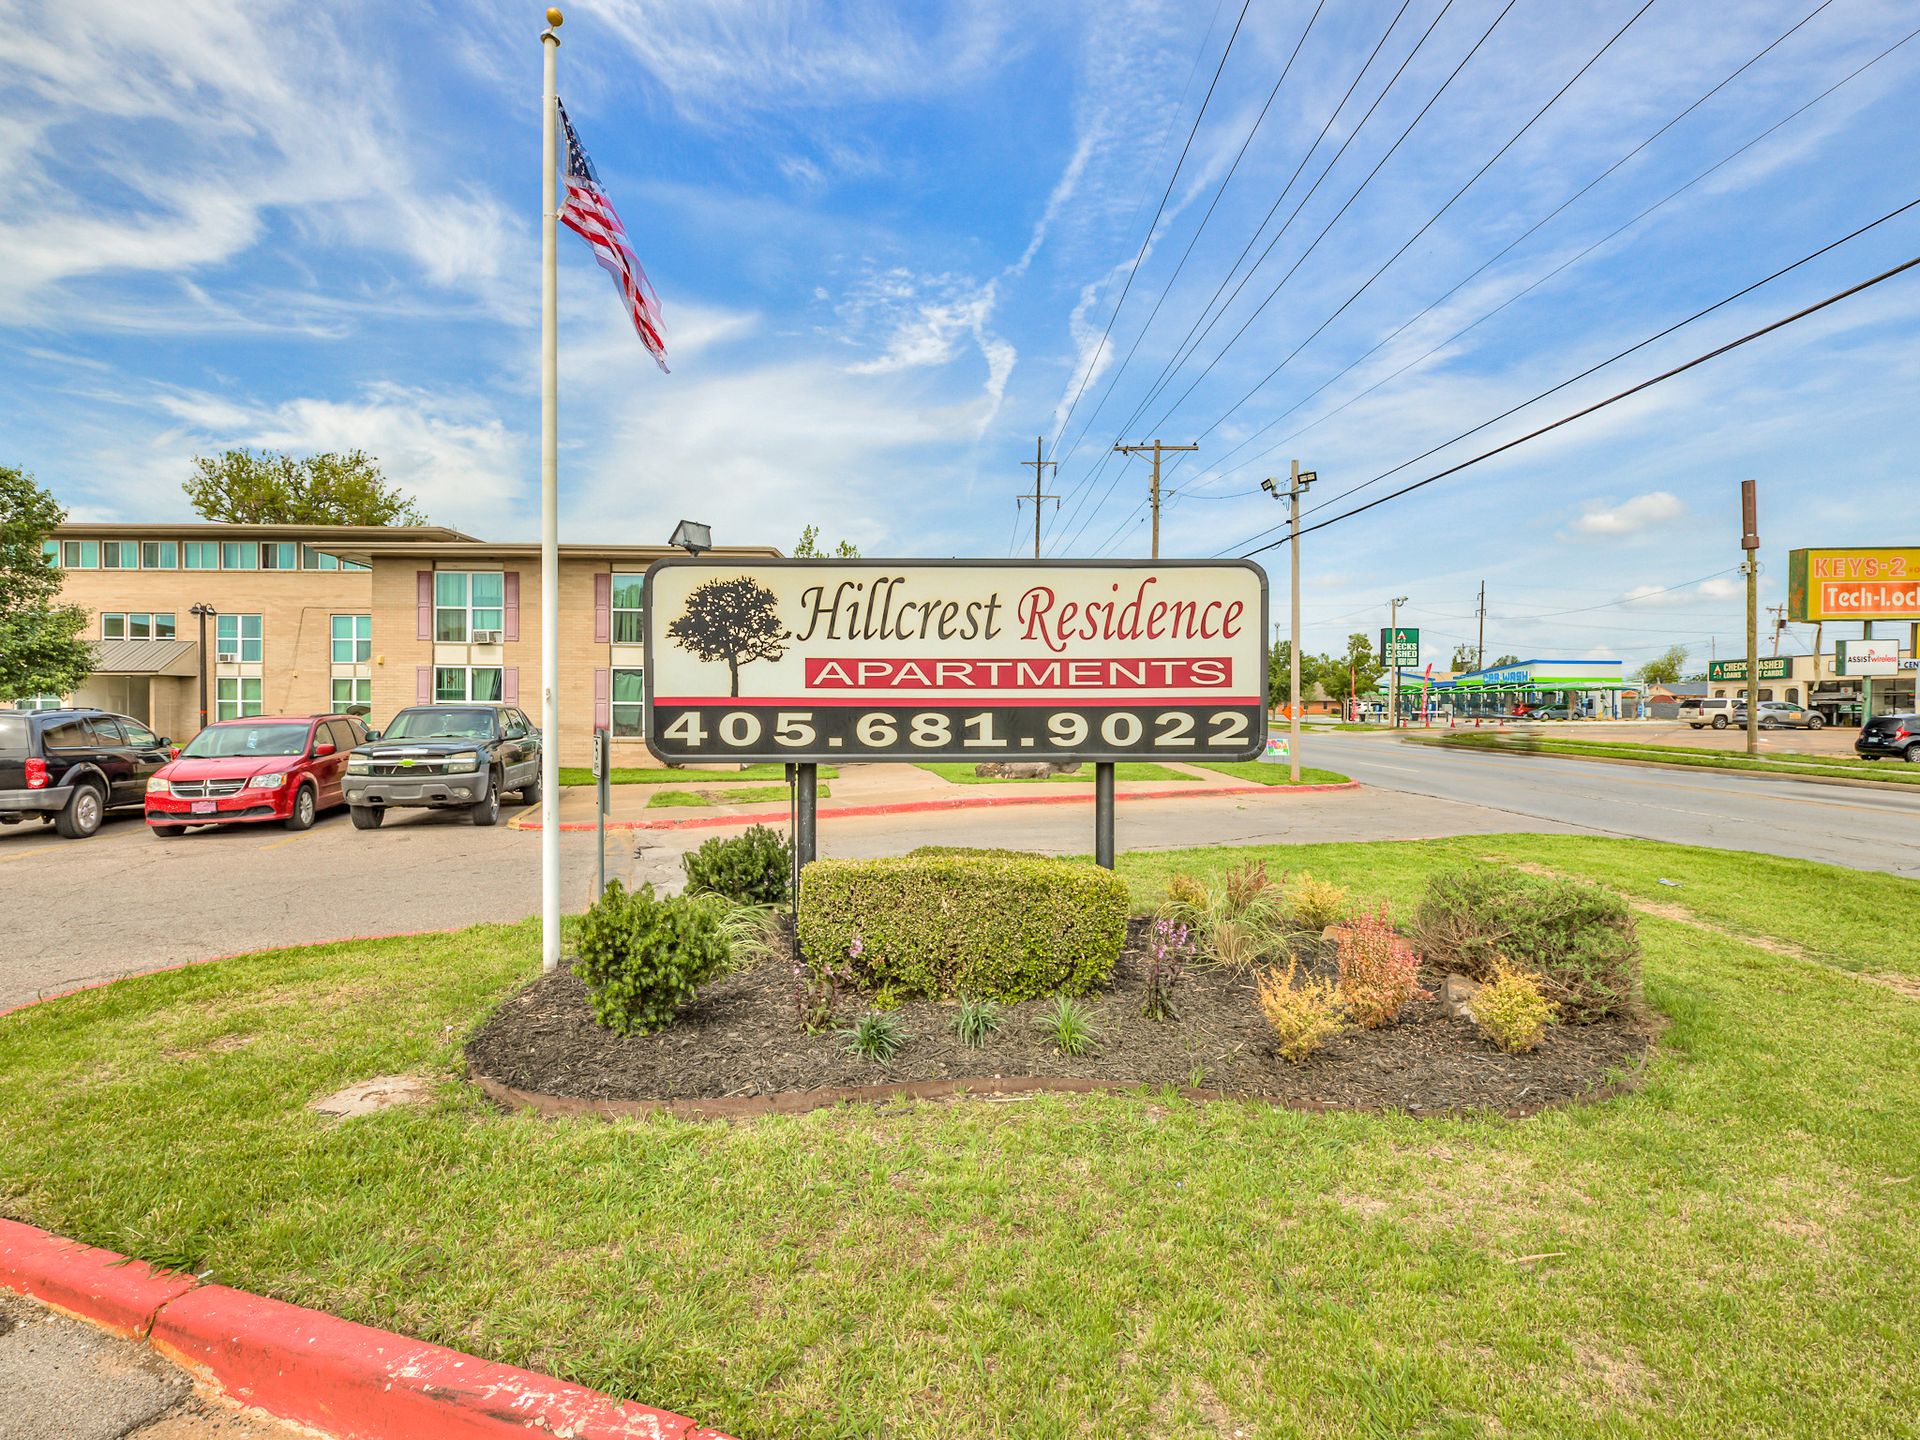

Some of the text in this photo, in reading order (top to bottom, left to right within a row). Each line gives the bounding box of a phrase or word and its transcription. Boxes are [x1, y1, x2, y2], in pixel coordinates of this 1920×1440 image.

[1813, 556, 1907, 578] KEYS-2
[796, 576, 1244, 653] Hillcrest Residence
[1723, 662, 1749, 672] CHECK
[1848, 654, 1897, 663] ASSIST wireless
[813, 660, 1227, 686] APARTMENTS
[1483, 671, 1528, 684] CAR WASH
[663, 711, 1250, 747] 405.681.9022
